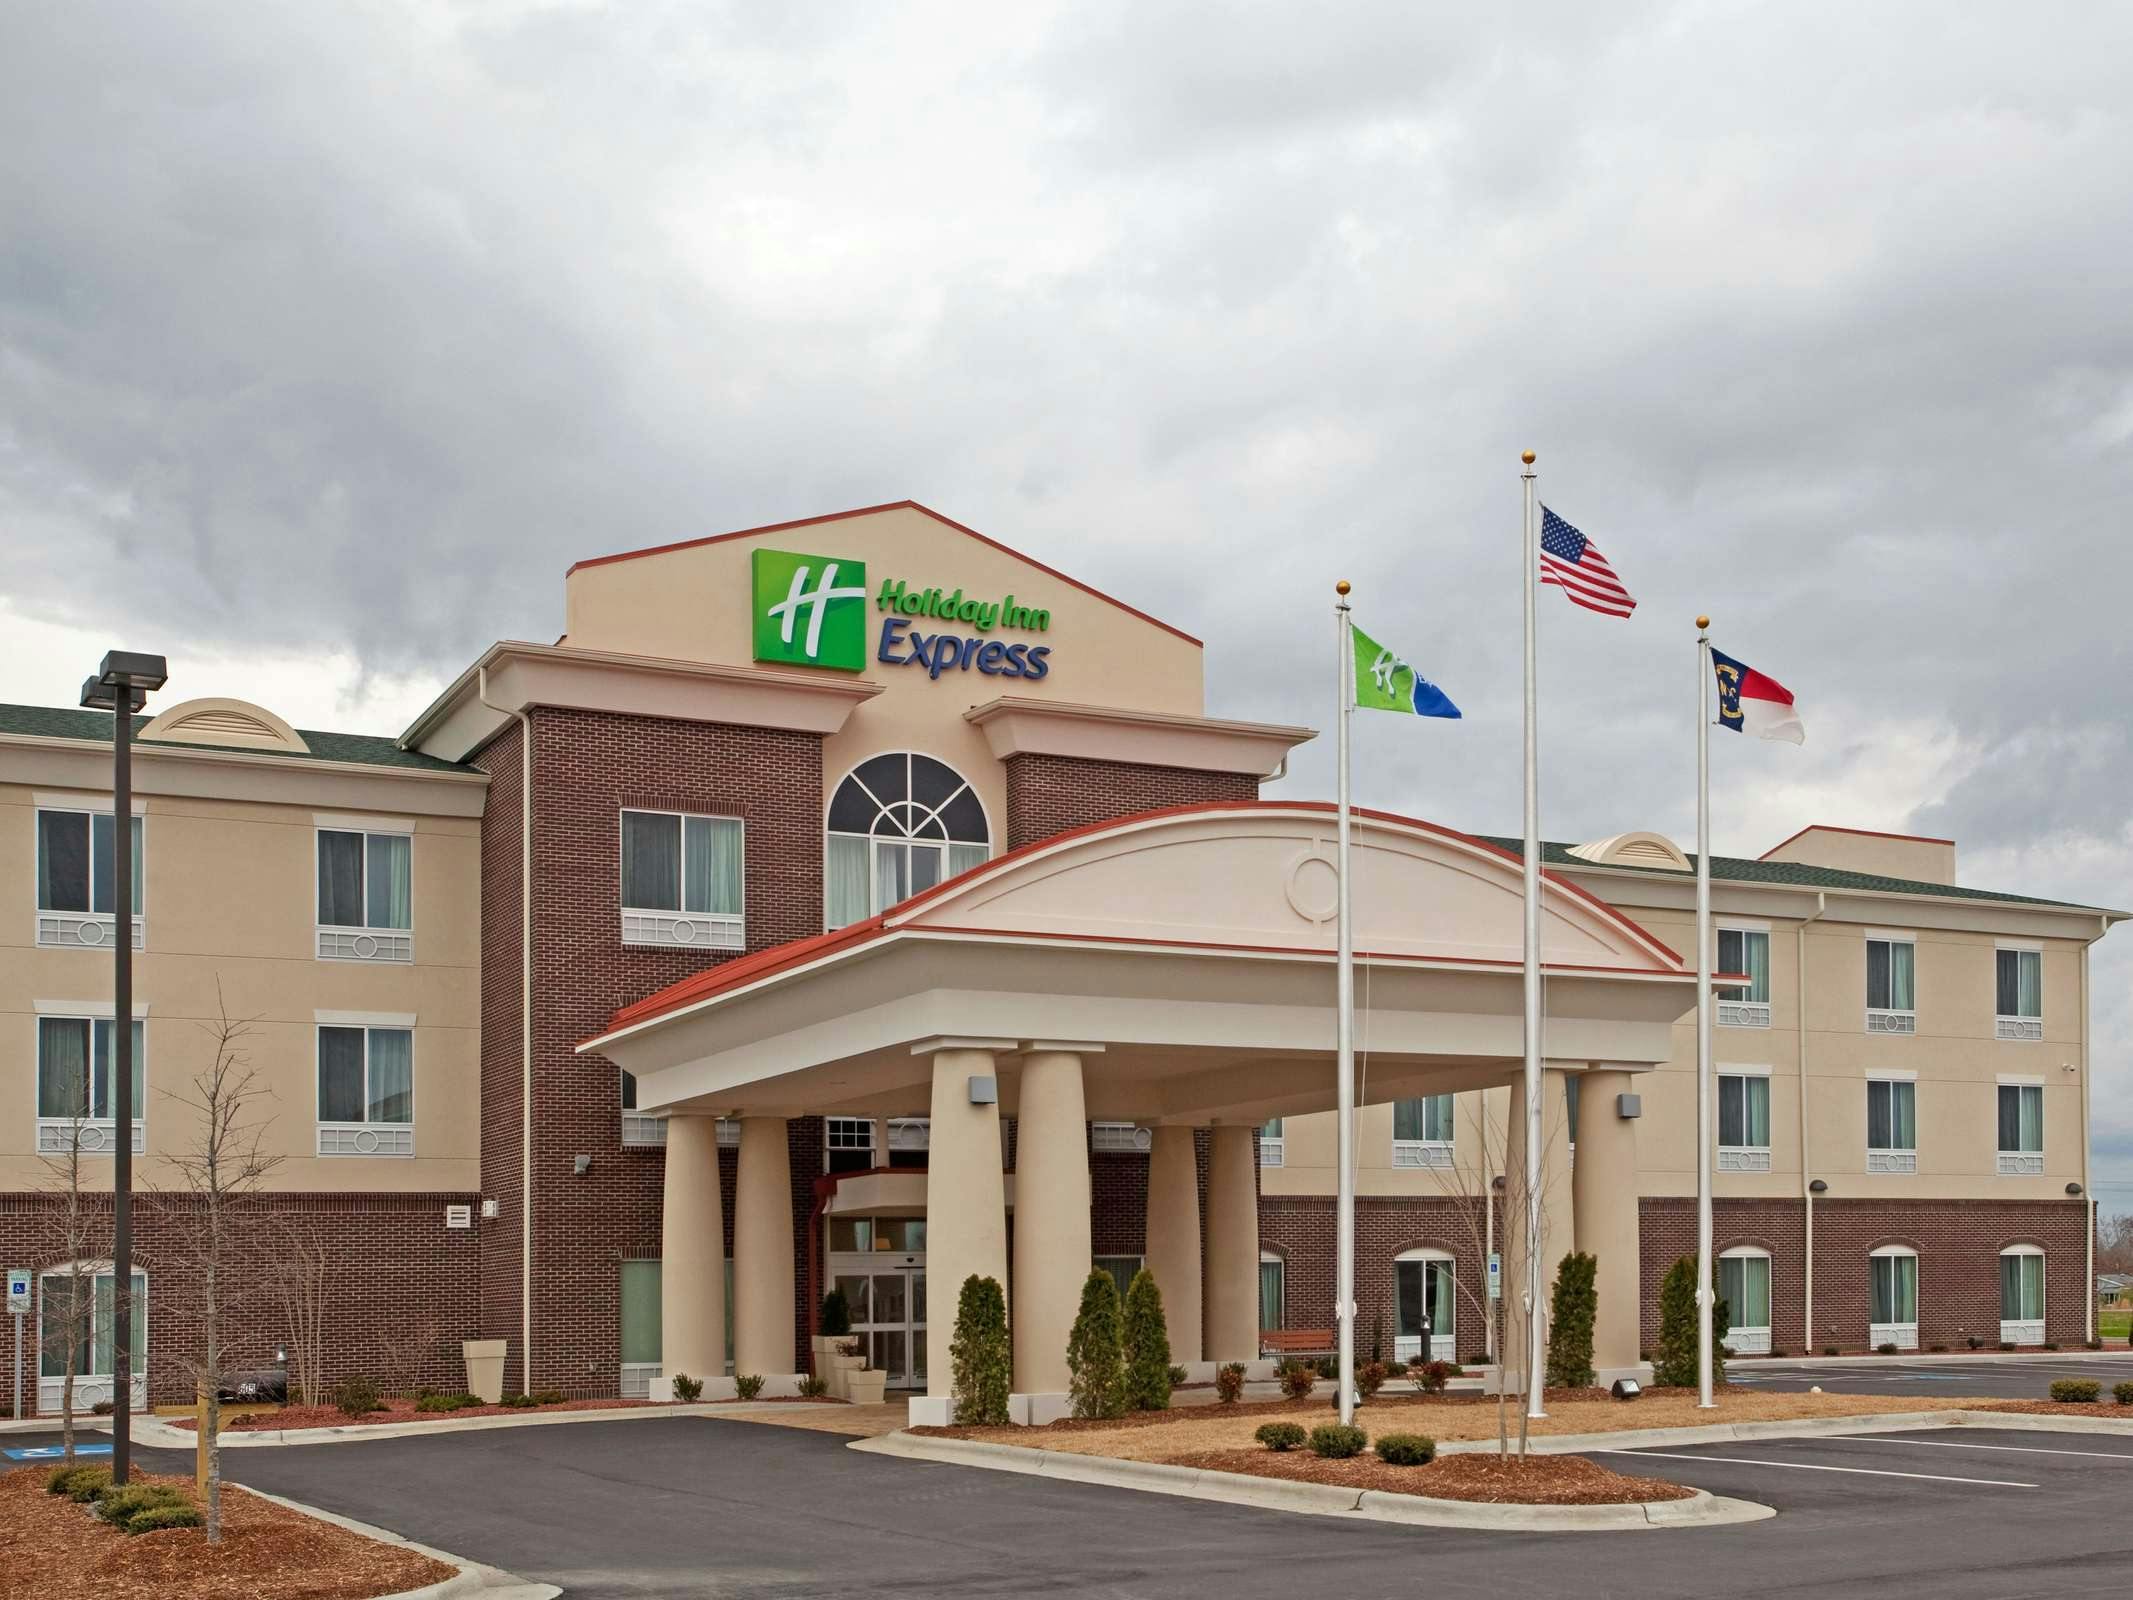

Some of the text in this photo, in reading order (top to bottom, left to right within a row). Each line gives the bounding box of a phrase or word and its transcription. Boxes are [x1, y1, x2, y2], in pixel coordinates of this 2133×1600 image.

[876, 579, 1050, 631] Holiday Inn
[878, 617, 1051, 681] Express
